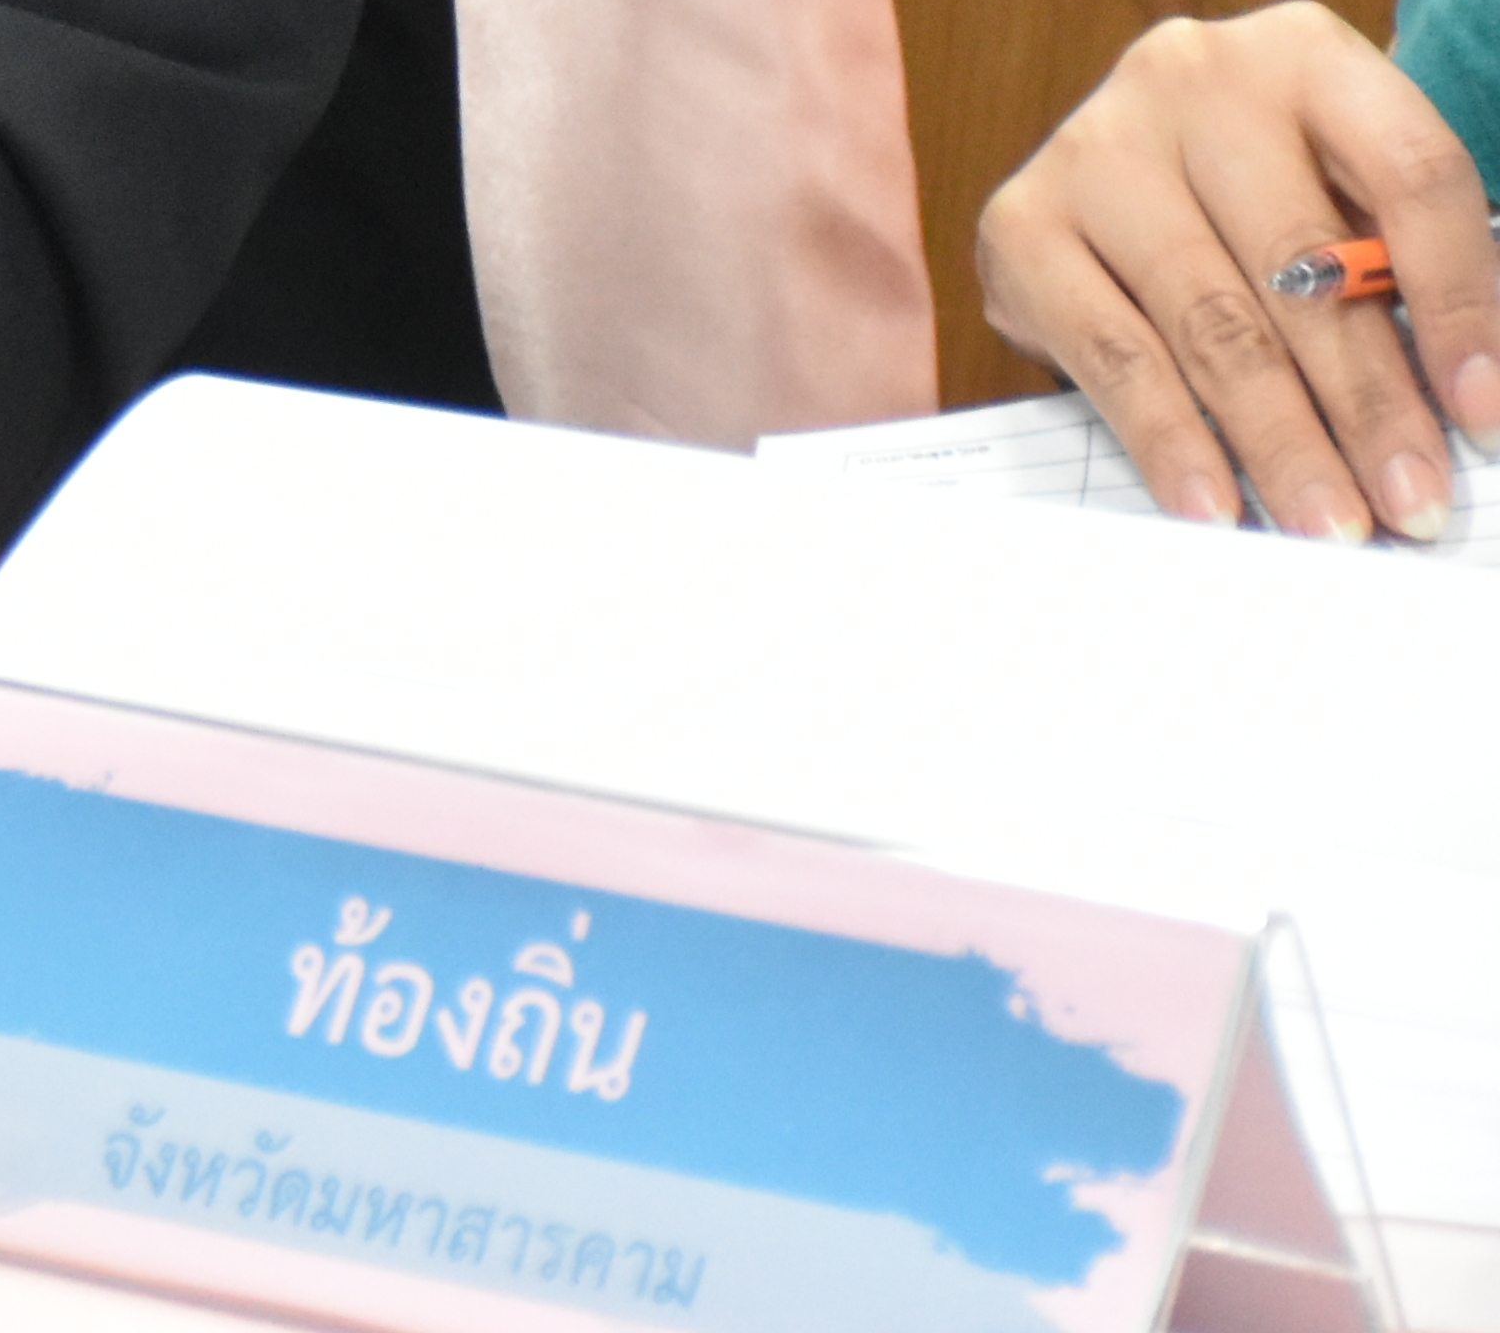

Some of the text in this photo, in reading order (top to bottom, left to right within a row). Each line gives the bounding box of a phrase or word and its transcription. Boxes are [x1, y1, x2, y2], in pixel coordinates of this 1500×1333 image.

[285, 895, 647, 1101] ท้องถิ่น
[102, 1102, 707, 1309] จังหวัดมหาสารคาม
